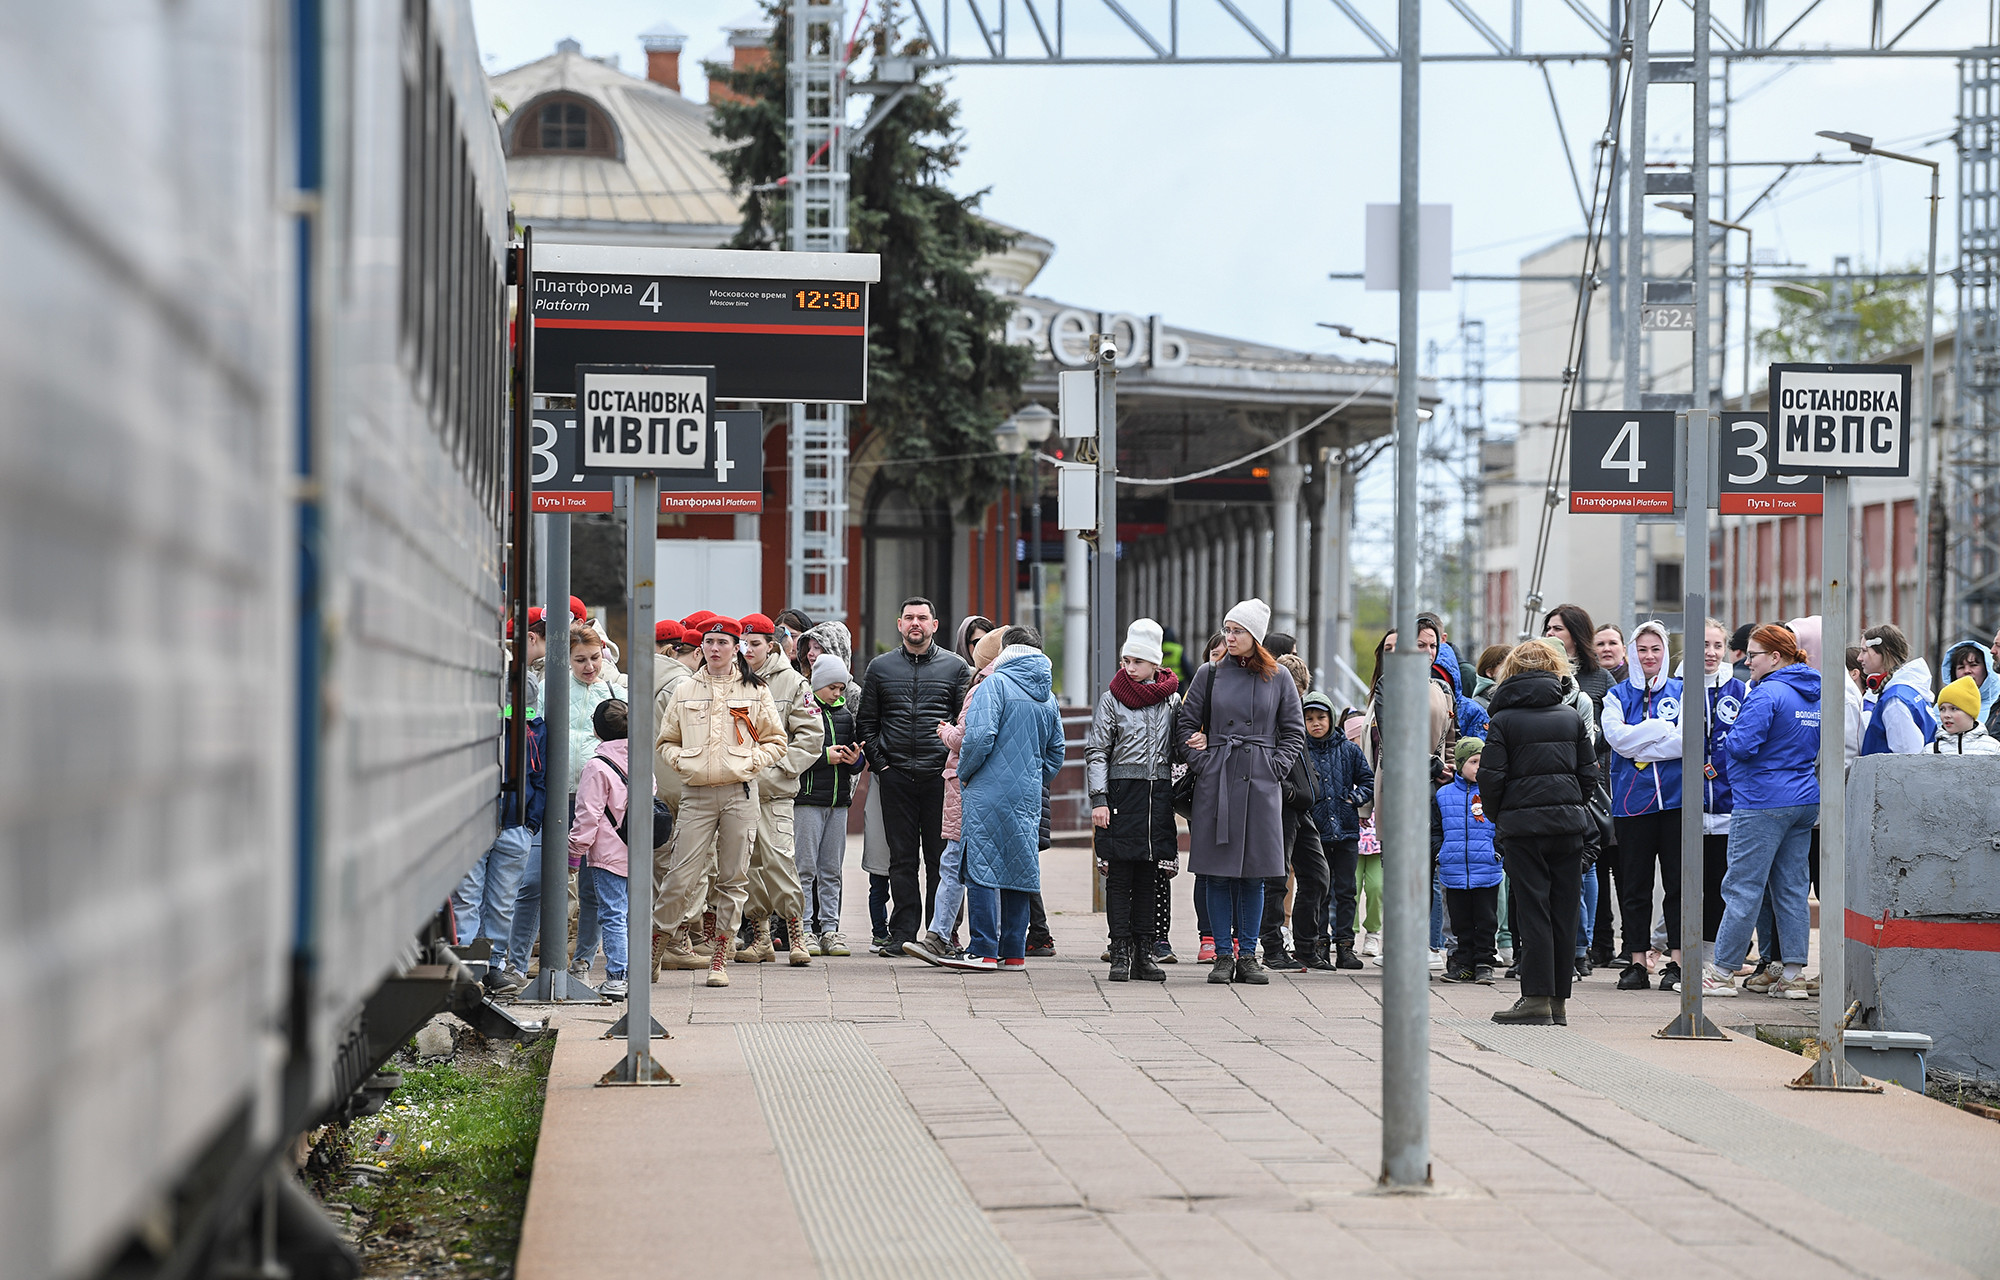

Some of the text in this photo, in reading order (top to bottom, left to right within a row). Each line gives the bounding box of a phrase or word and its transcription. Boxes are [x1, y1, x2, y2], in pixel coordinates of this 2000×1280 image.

[535, 278, 662, 313] Платформа 4
[709, 290, 786, 300] Московское время
[709, 299, 734, 307] Moscow
[795, 290, 860, 310] 12:30
[535, 299, 590, 311] Platform
[588, 390, 704, 413] ОСТАНОВКА
[1782, 388, 1899, 411] ОСТАНОВКА
[592, 416, 698, 455] МВПС
[1786, 415, 1893, 453] МВПС
[1600, 420, 1647, 484] 4
[1728, 420, 1809, 485] 3
[537, 497, 587, 508] Путь Track
[665, 497, 757, 508] Платформа Platform
[1576, 497, 1668, 509] Платформа Platform
[1747, 498, 1797, 509] Путь Track
[1795, 710, 1821, 719] ВОЛОНТЁ
